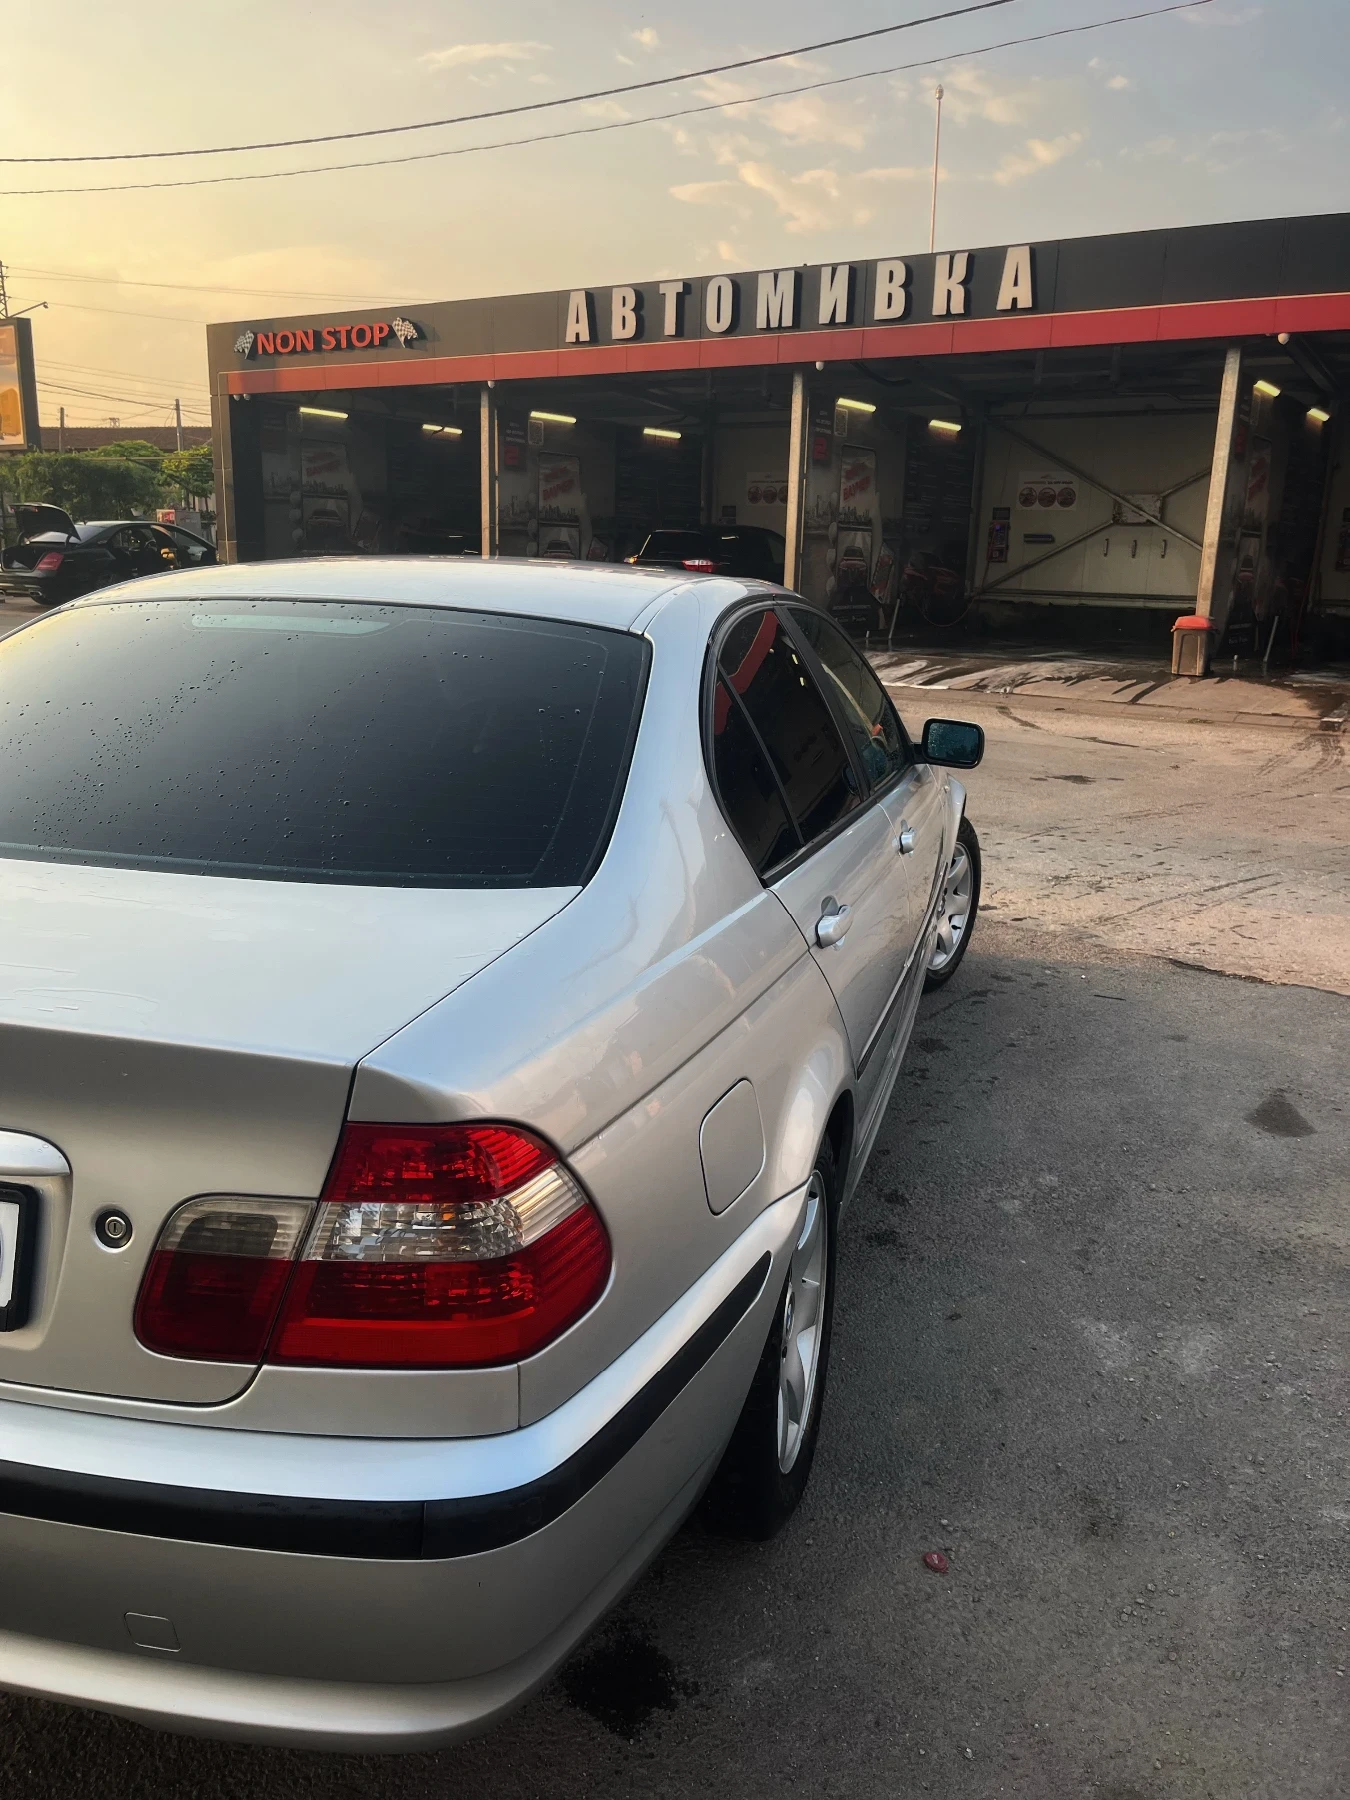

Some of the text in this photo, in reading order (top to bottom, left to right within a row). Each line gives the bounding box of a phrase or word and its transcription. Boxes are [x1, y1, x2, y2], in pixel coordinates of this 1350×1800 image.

[565, 245, 1032, 343] АВТОМИВКА
[257, 322, 390, 355] NON STOP
